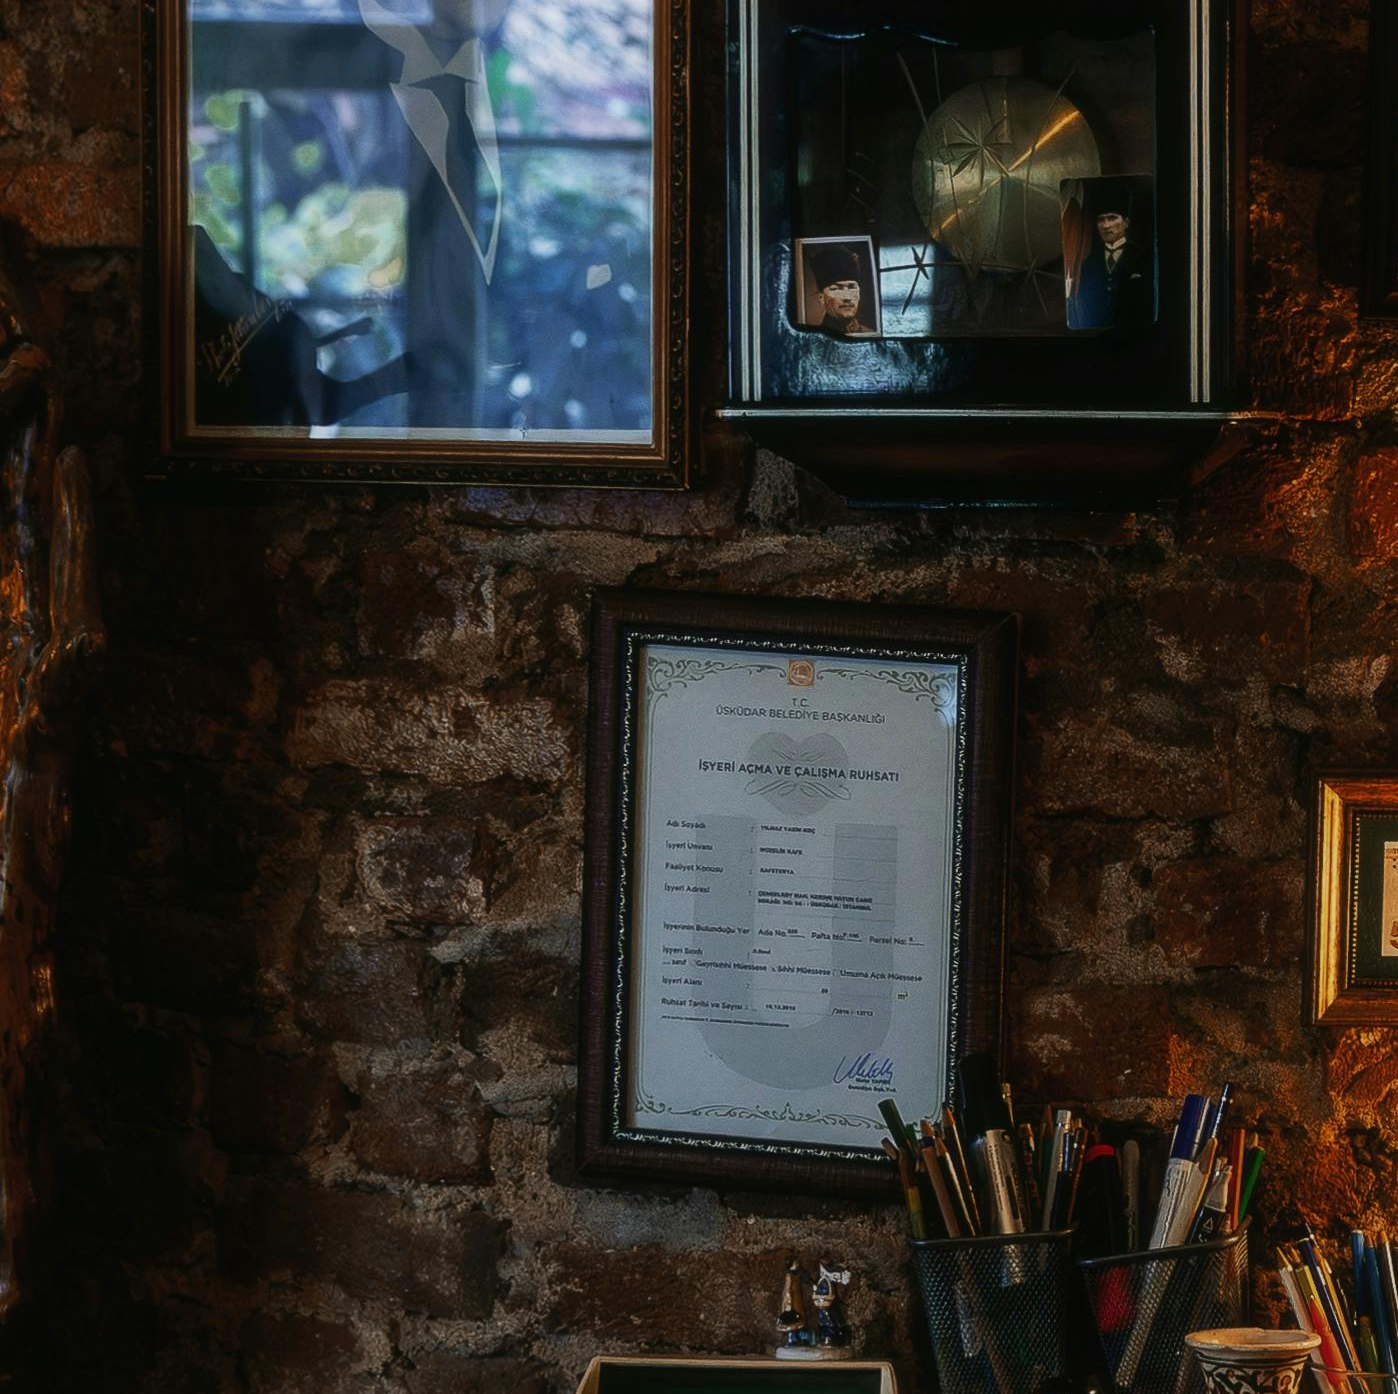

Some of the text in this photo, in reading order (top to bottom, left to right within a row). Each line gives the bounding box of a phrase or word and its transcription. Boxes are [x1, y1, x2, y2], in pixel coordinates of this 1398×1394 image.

[716, 704, 886, 724] ÜSKÜDAR BELEDİYE BAŞKANLIĞI
[698, 758, 899, 782] İŞYERİ AÇMA VE ÇALIŞMA RUHSATI
